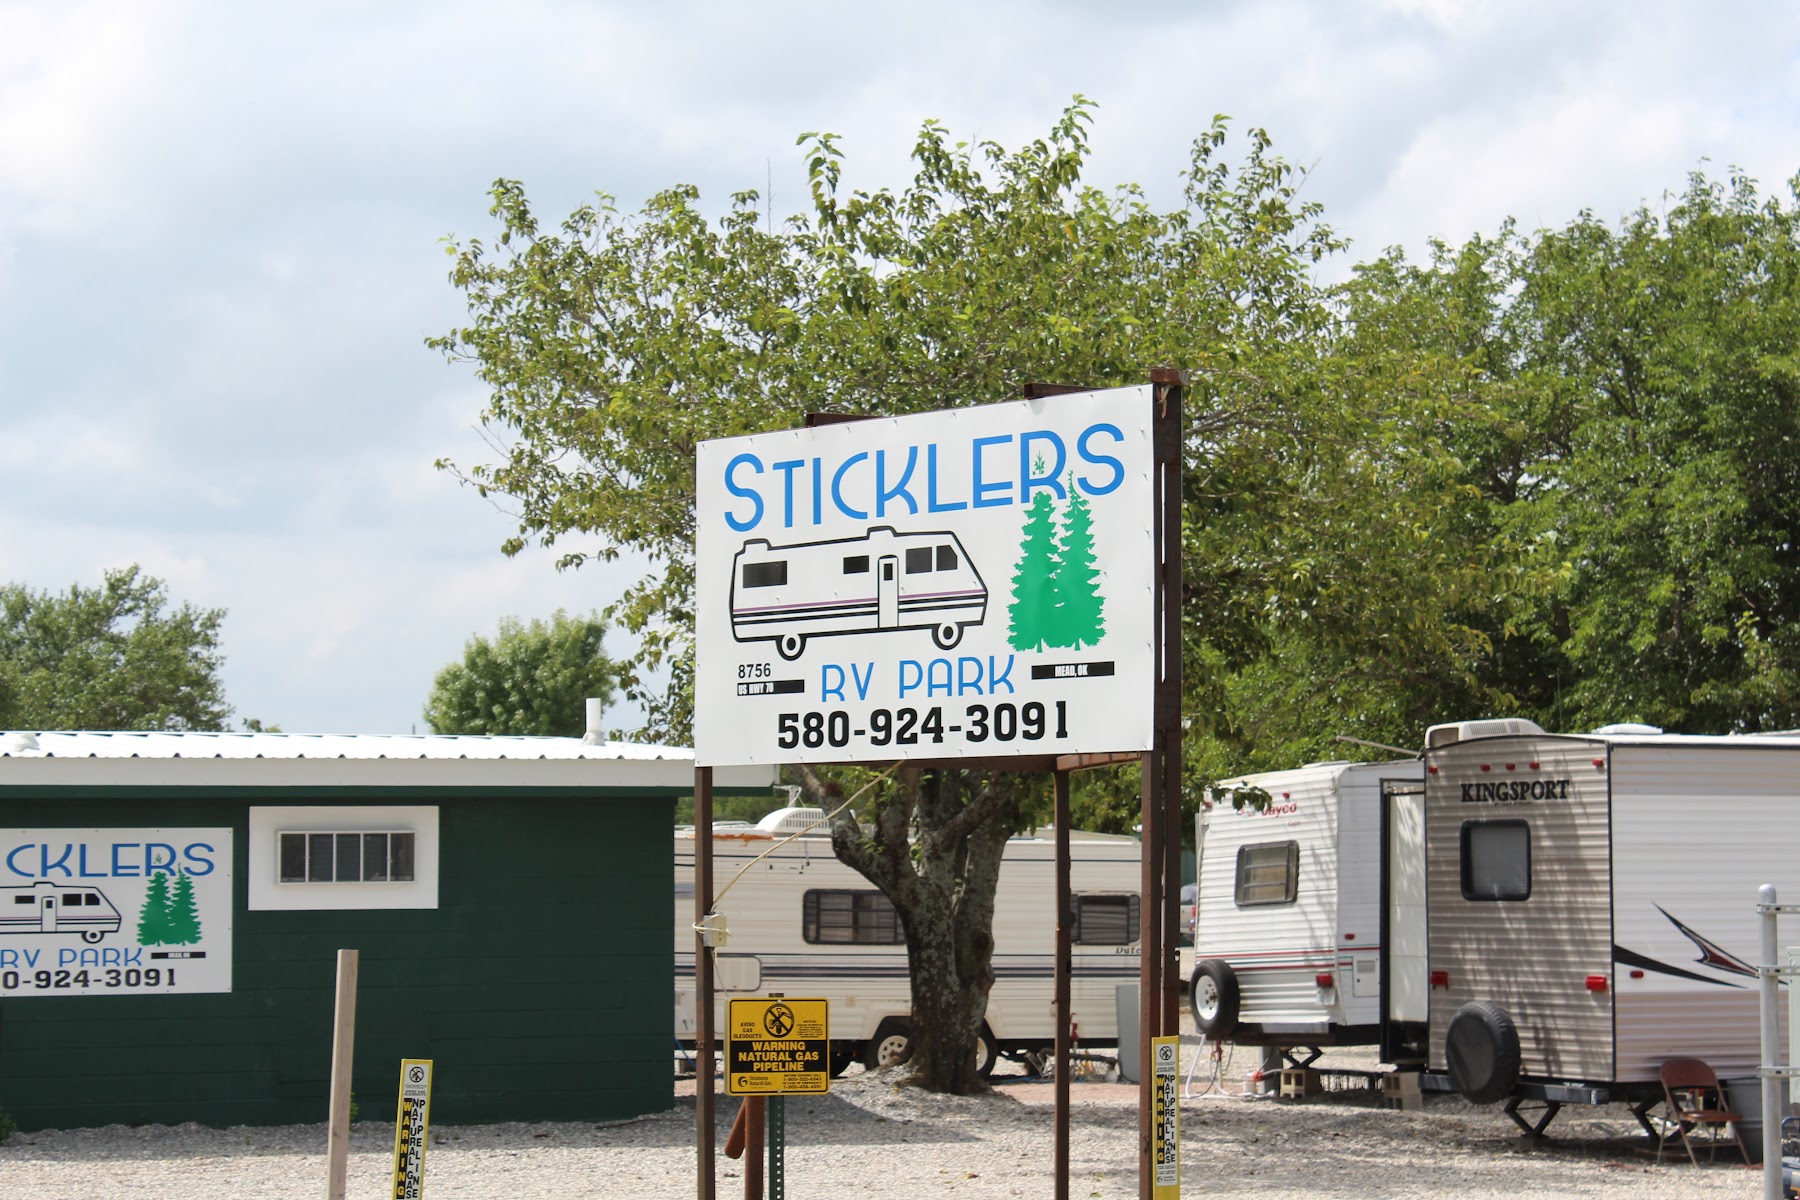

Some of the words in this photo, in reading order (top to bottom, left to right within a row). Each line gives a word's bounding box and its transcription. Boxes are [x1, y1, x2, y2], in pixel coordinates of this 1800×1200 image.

[724, 423, 1125, 532] STICKLERS
[738, 663, 771, 679] 8756
[821, 662, 874, 703] RV
[899, 654, 1015, 699] PARK
[1055, 665, 1077, 677] MEAD,
[1077, 664, 1088, 676] OK
[738, 684, 747, 695] US
[748, 683, 764, 694] HWY
[765, 682, 774, 693] 70
[777, 700, 1068, 749] 580-924-3091
[1460, 779, 1569, 803] KINGSPORT
[0, 949, 40, 968] RV
[59, 948, 142, 968] PARK
[738, 1051, 792, 1062] NATURAL
[795, 1051, 819, 1061] GAS
[752, 1041, 806, 1051] WARNING
[753, 1062, 804, 1072] PIPELINE
[408, 1098, 420, 1166] NATURAL
[1157, 1078, 1165, 1161] WARNING
[397, 1101, 412, 1197] WARNING
[412, 1099, 426, 1199] PIPELINE
[405, 1171, 413, 1199] GAS
